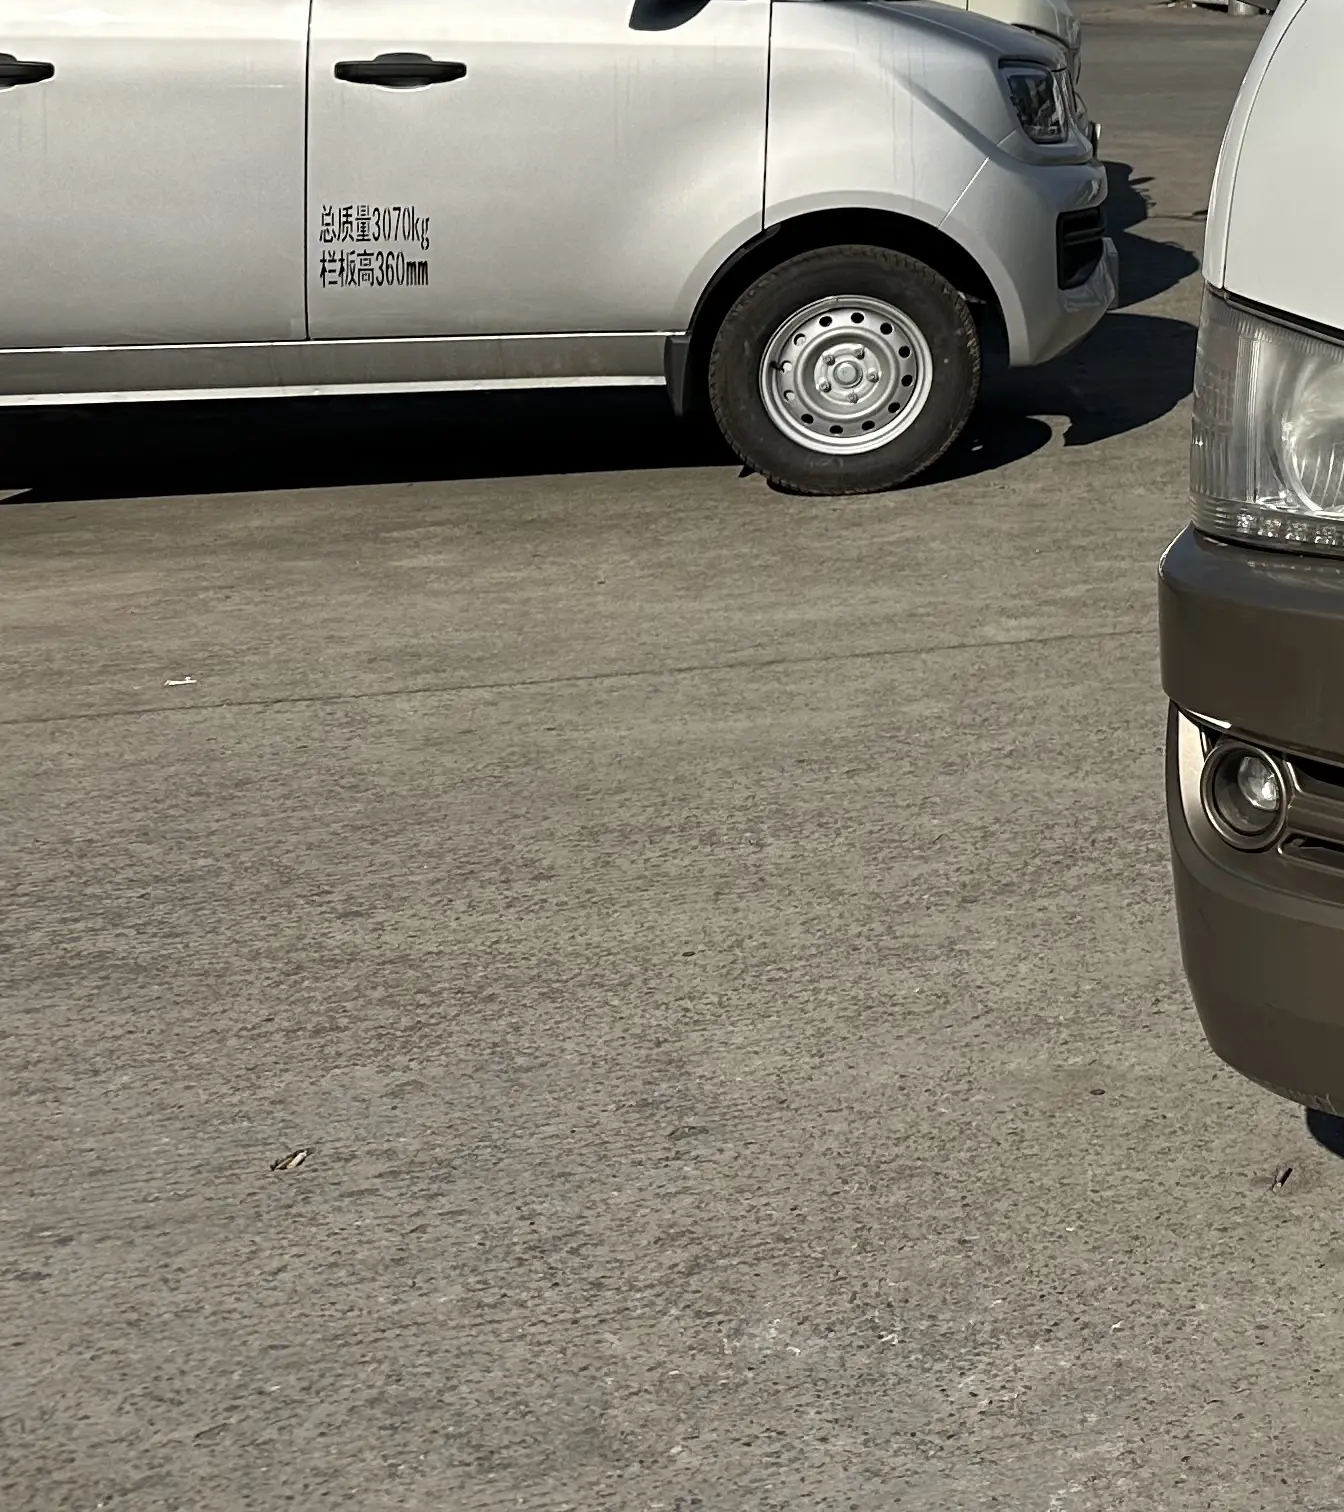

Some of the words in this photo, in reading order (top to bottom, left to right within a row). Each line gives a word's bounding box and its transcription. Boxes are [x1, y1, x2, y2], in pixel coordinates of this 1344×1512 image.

[319, 204, 430, 251] 总质量3070kg
[320, 249, 429, 289] 栏板高360mm
